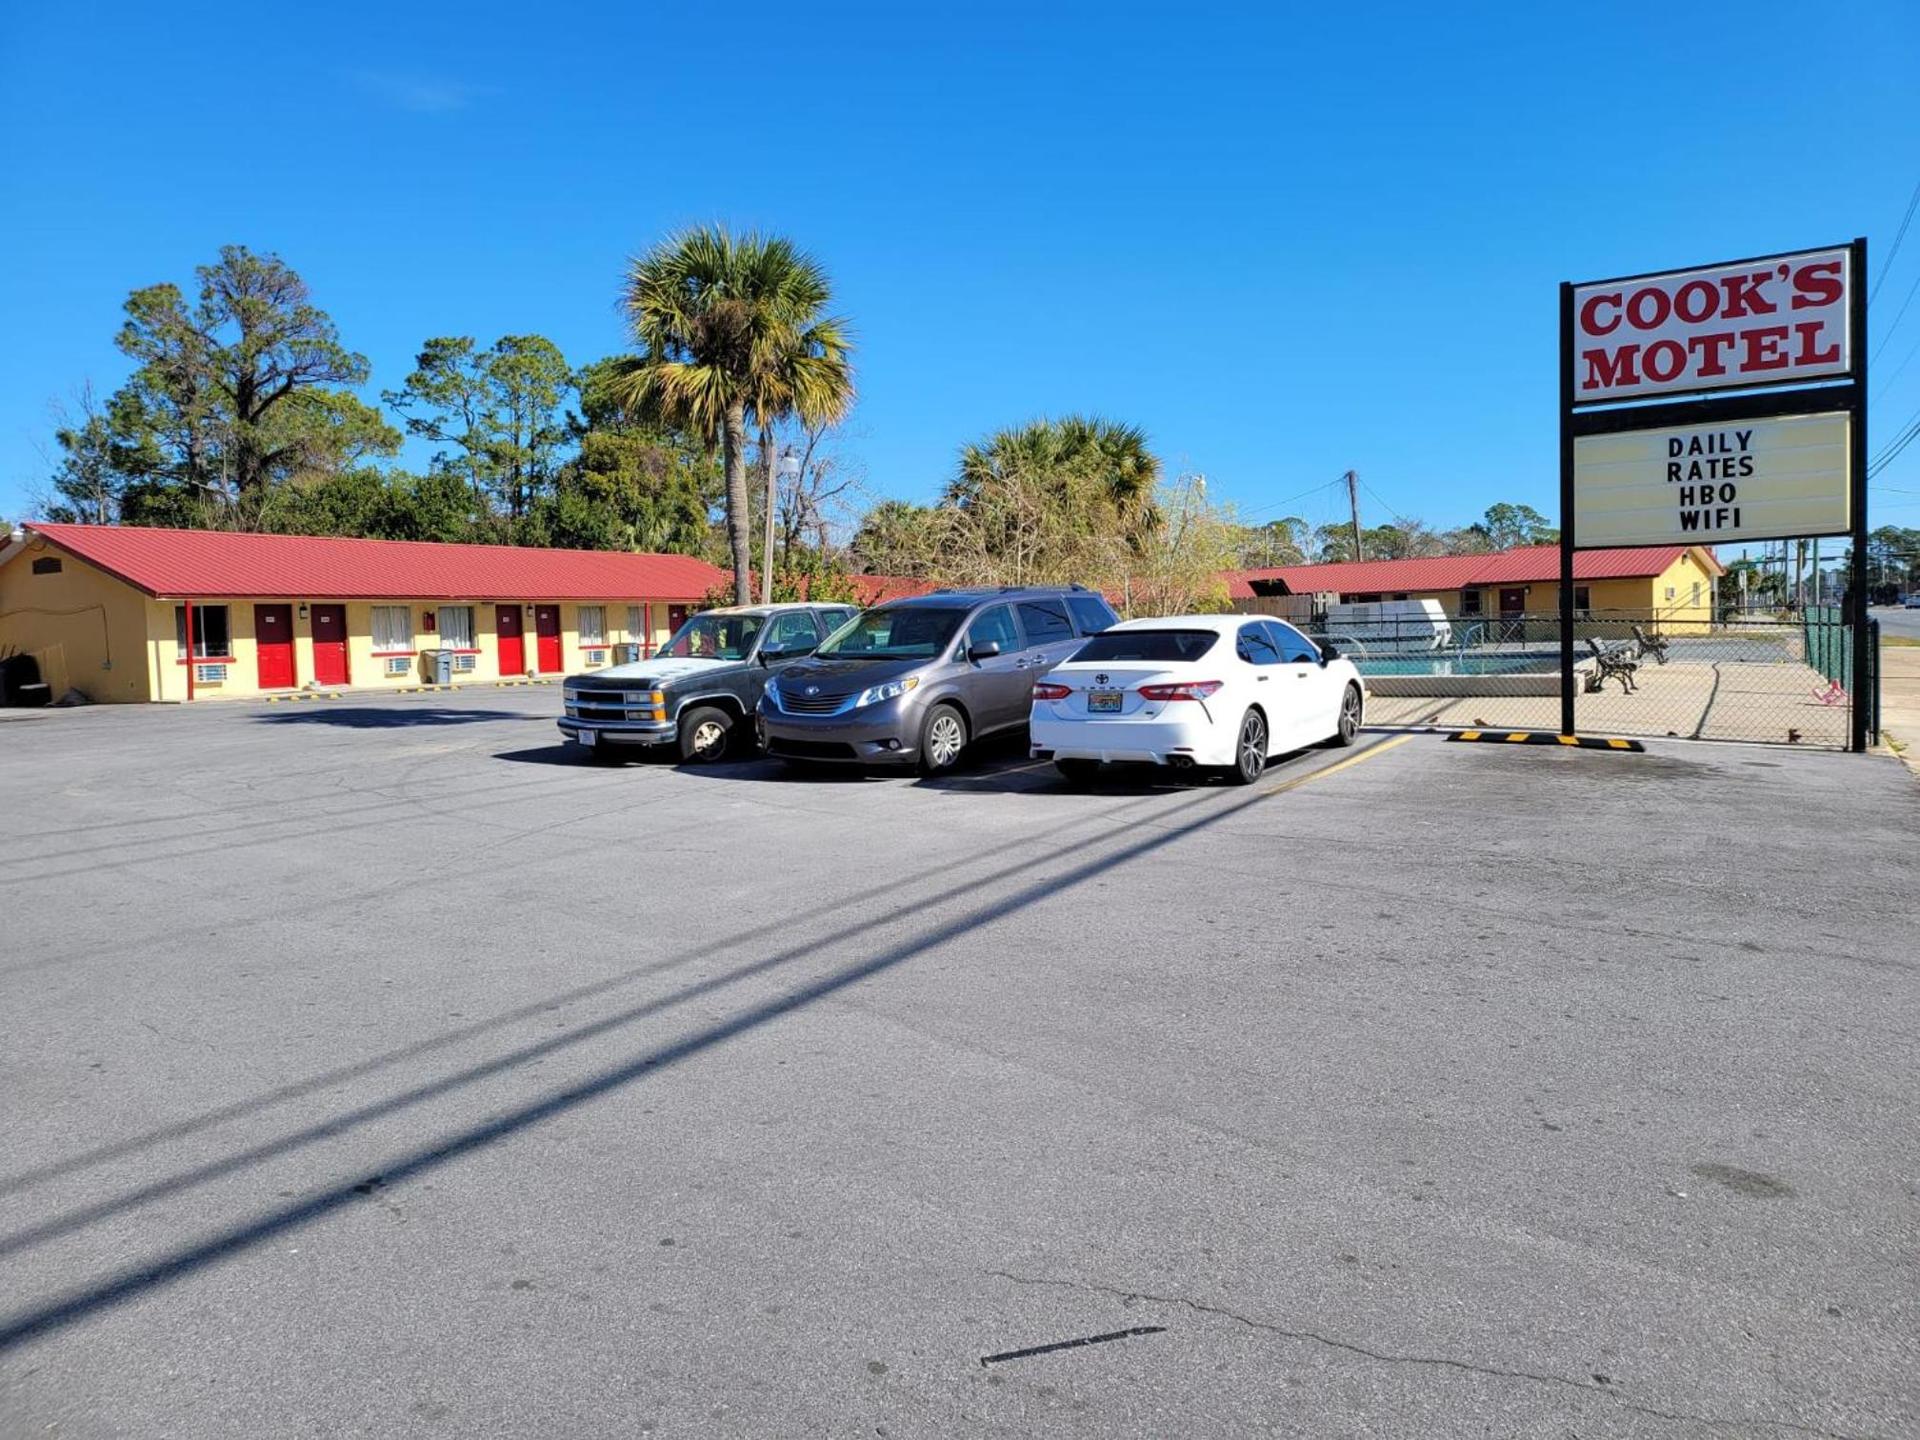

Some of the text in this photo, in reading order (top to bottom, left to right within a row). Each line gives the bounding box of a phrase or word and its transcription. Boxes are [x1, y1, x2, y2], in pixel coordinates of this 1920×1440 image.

[1580, 261, 1844, 336] COOK'S
[1582, 320, 1840, 390] MOTEL
[1668, 430, 1753, 458] DAILY
[1667, 456, 1754, 482] RATES
[1680, 482, 1736, 507] HBO
[1680, 507, 1741, 531] WIFI
